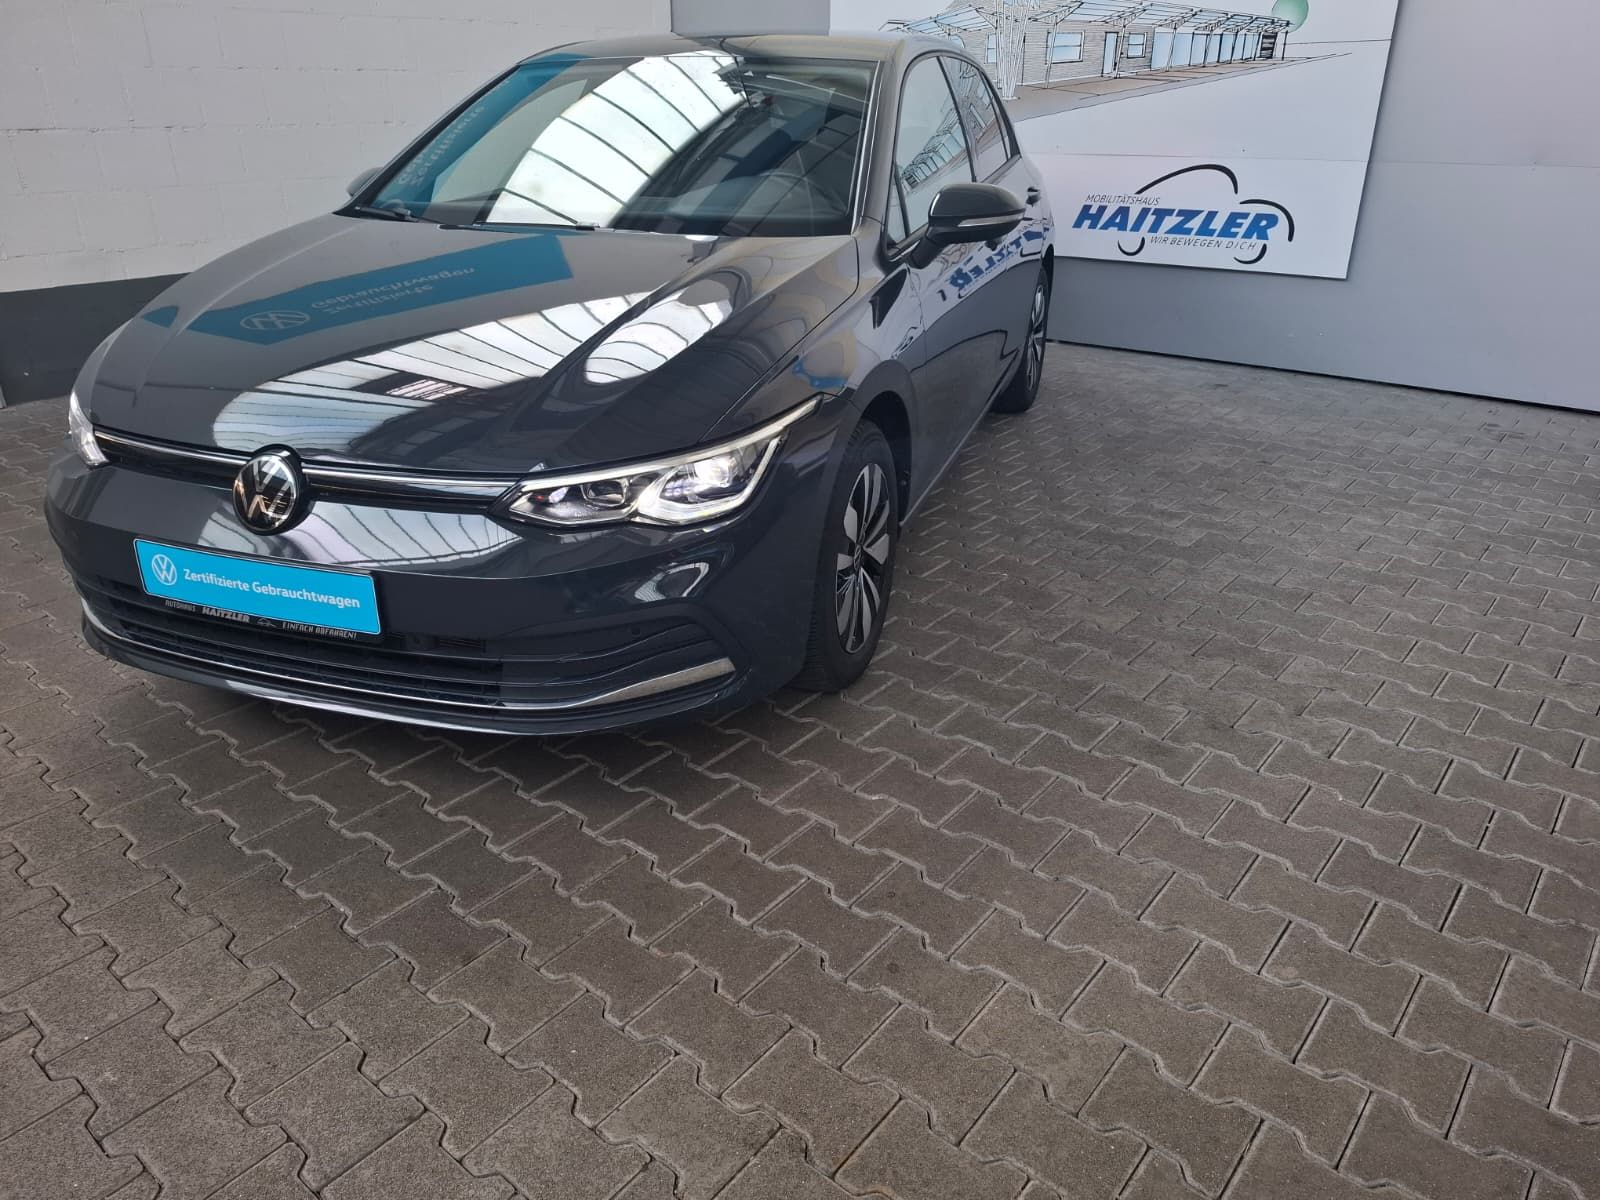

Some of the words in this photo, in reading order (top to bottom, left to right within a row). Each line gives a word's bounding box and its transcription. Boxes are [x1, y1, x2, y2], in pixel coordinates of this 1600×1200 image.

[1085, 192, 1160, 206] MOBILITÄTSHAUS
[1072, 204, 1279, 241] HAITZLER
[1150, 235, 1169, 245] WIR
[1170, 237, 1223, 249] BEWEGEN
[1225, 240, 1257, 250] DICH
[183, 568, 250, 592] Zertifizierte
[252, 581, 360, 609] Gebrauchtwagen
[202, 606, 250, 624] HAITZLER
